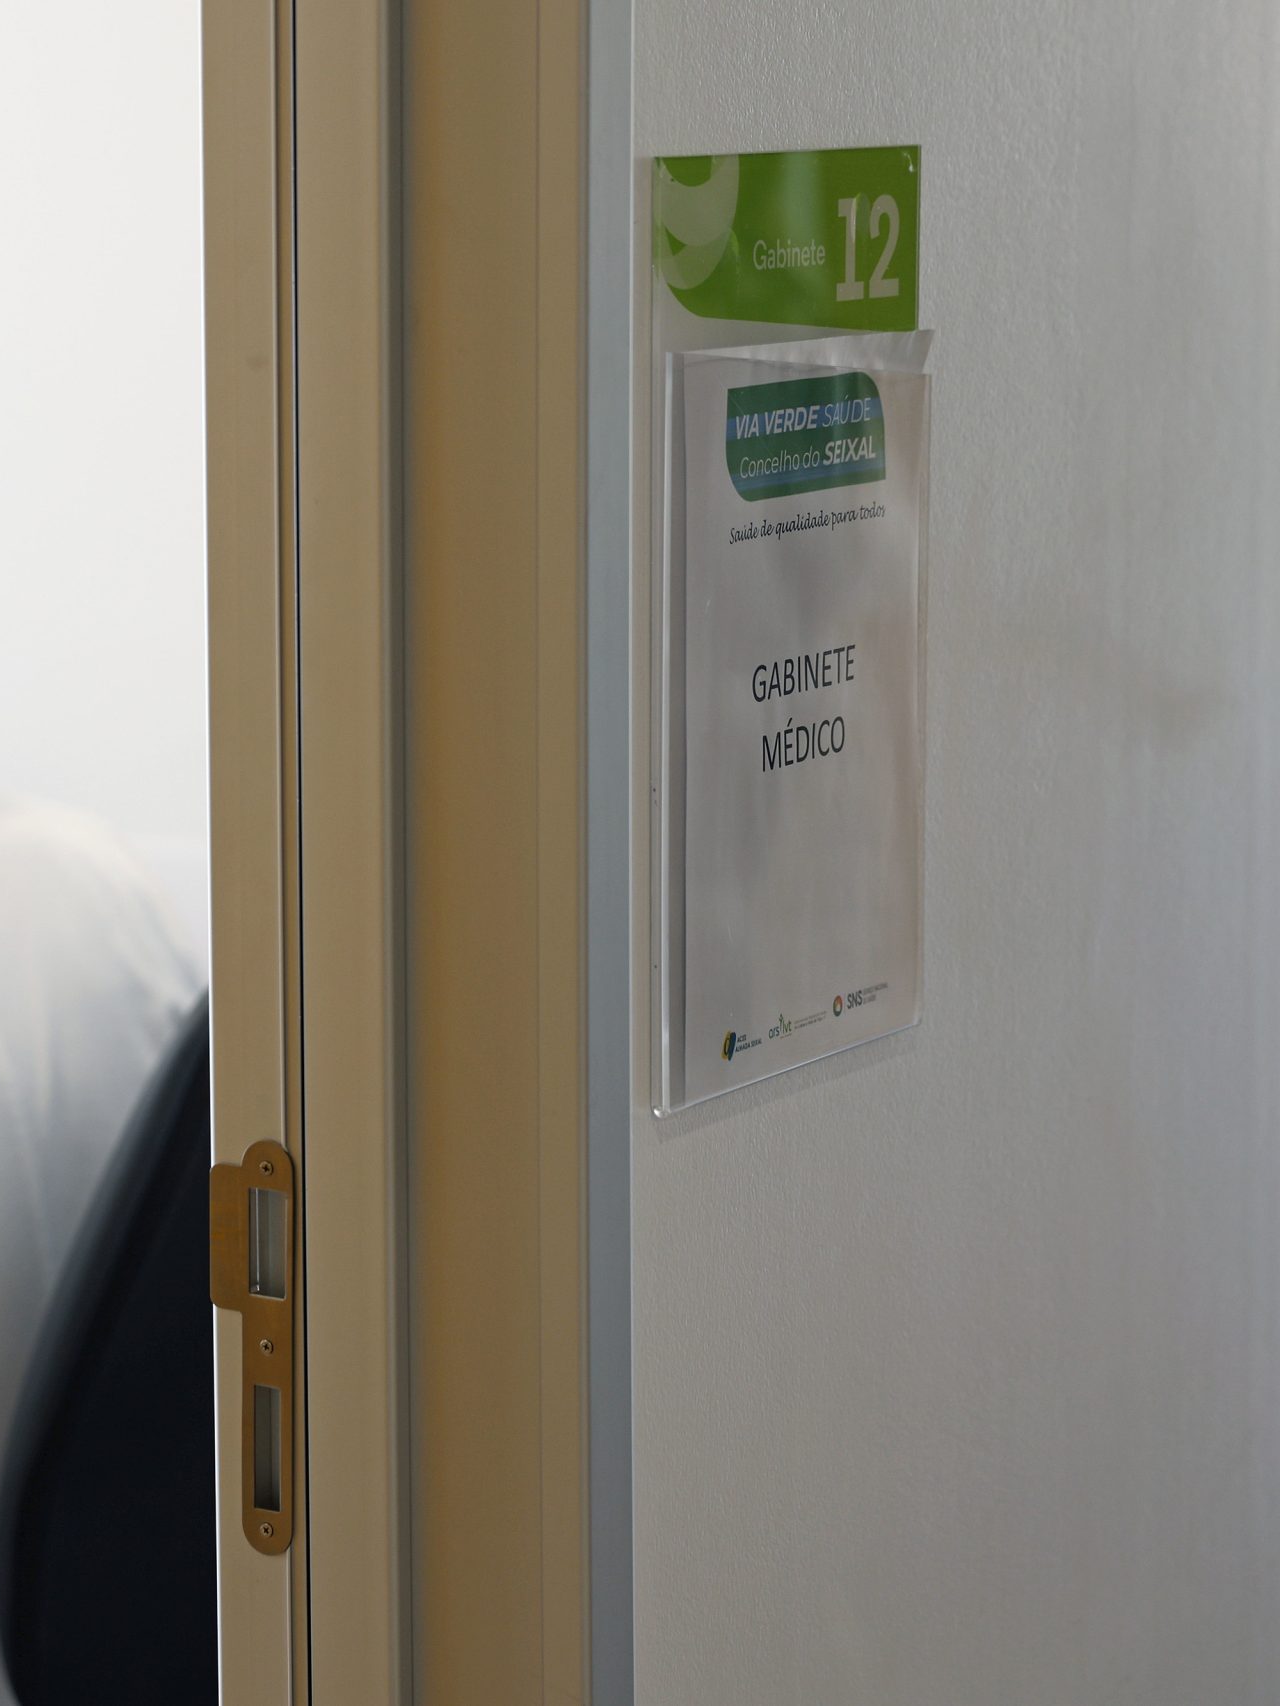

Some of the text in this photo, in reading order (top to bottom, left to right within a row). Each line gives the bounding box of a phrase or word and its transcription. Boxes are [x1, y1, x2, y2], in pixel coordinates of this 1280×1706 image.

[753, 194, 900, 301] Gabinete 12
[735, 394, 872, 440] VIA VERDE SAÚDE
[739, 435, 876, 479] Concelho do SEIXAL
[760, 519, 775, 537] de
[775, 510, 830, 540] qualidade
[831, 508, 859, 531] para
[859, 501, 886, 520] todos
[752, 644, 856, 702] GABINETE
[762, 717, 845, 772] MÉDICO
[846, 990, 863, 1009] SNS
